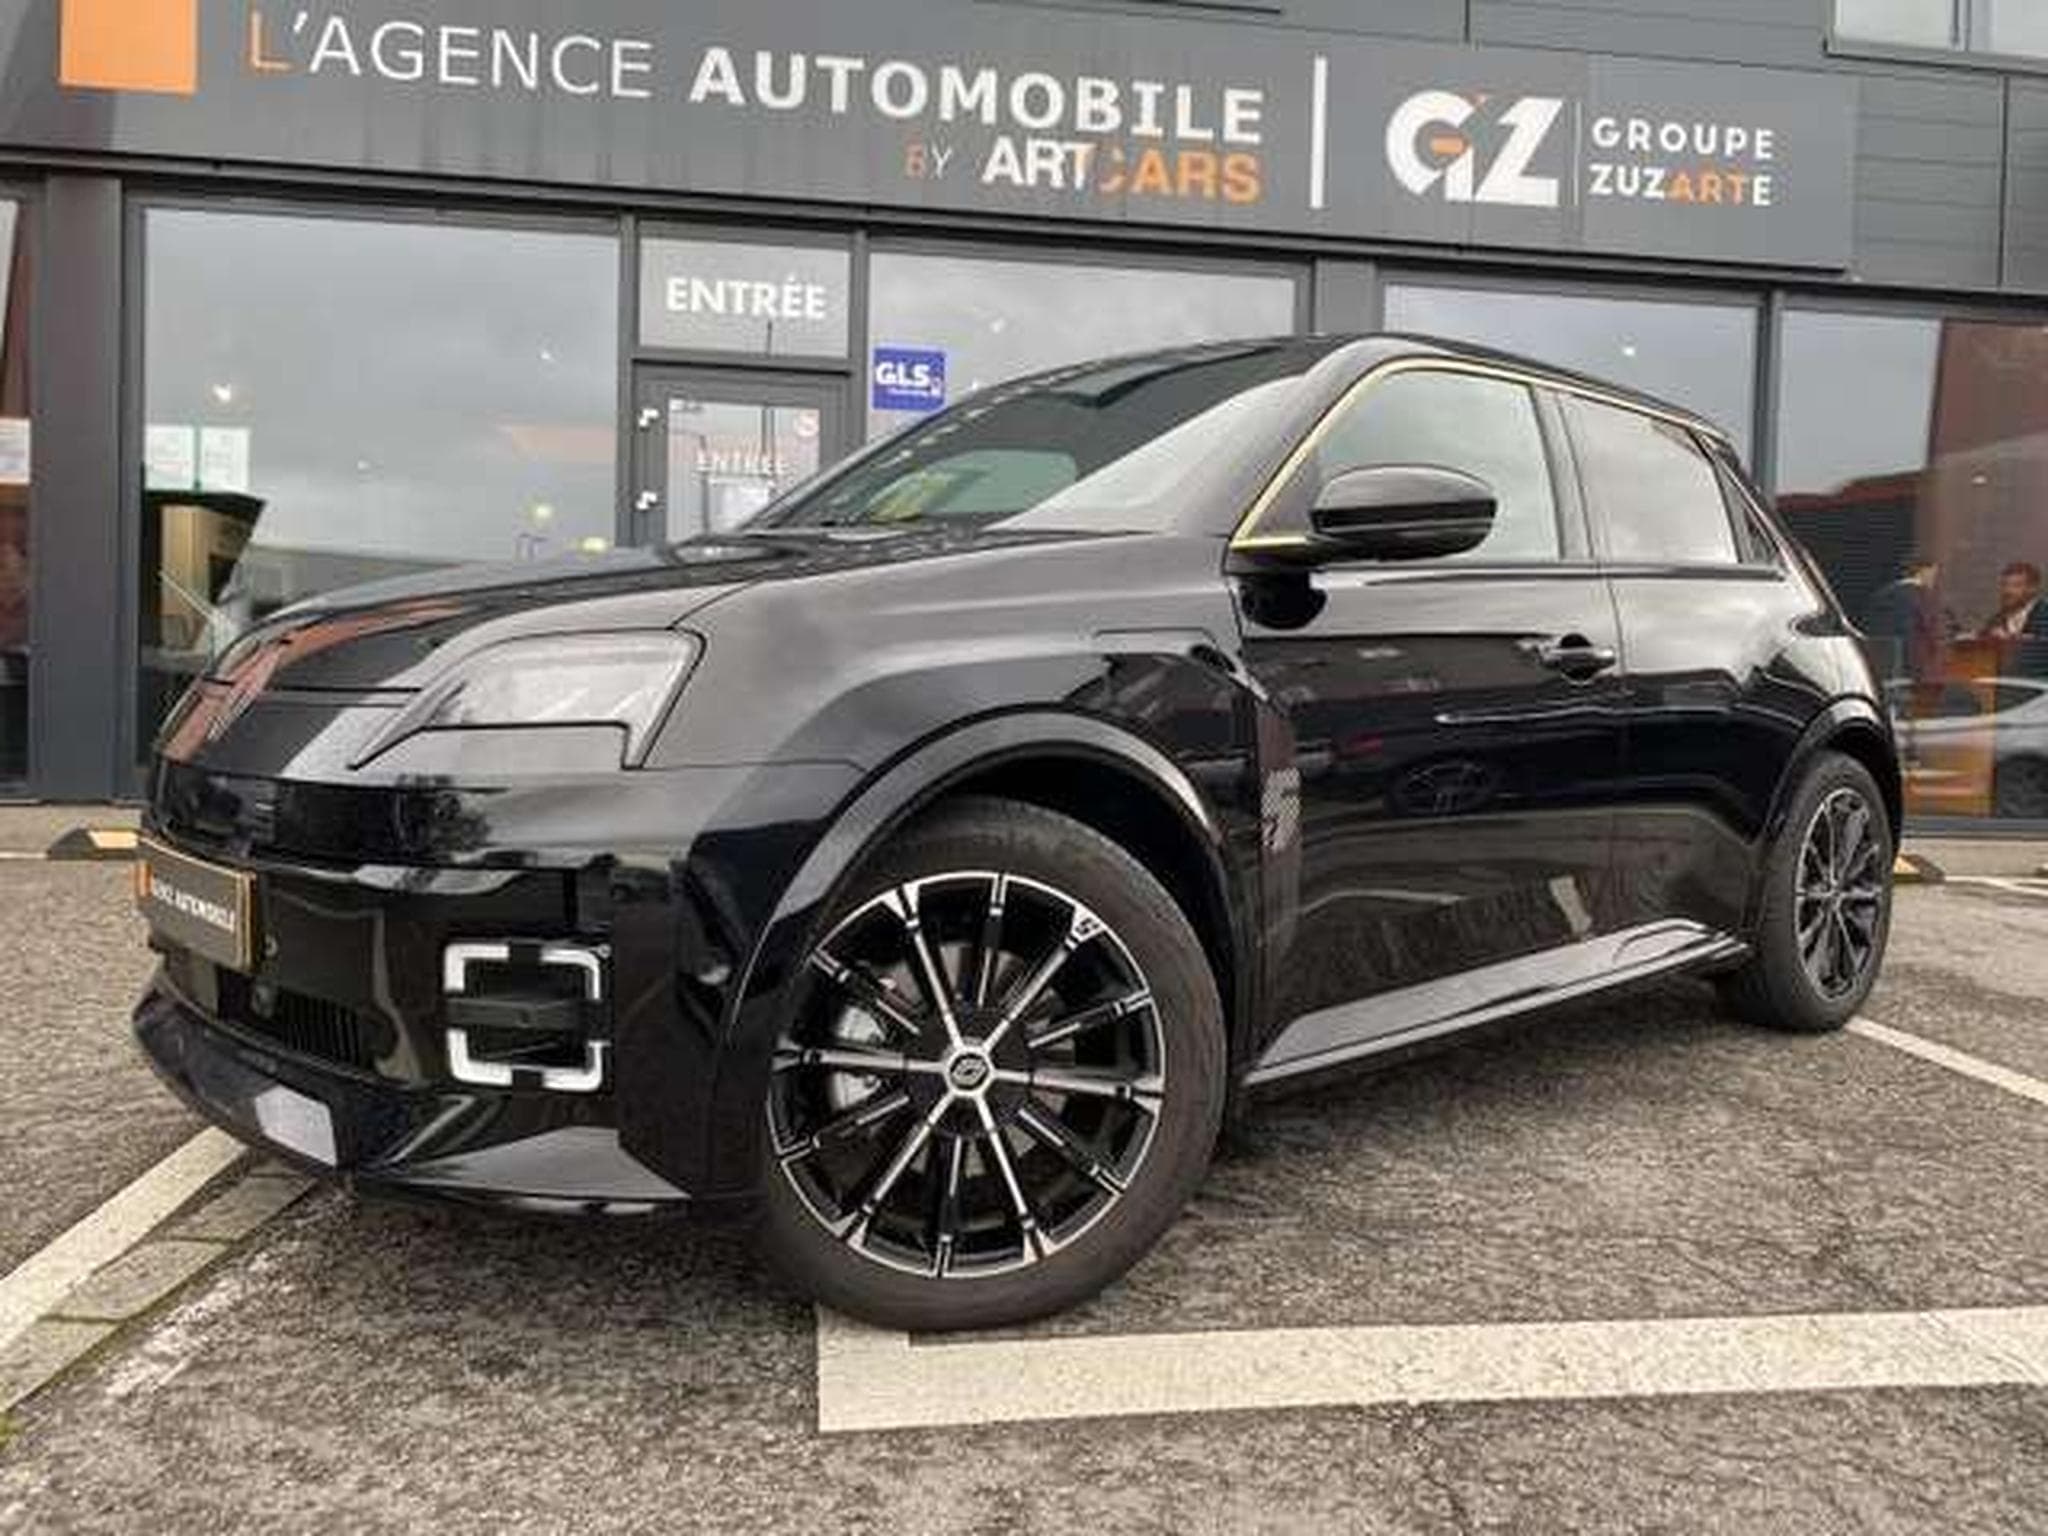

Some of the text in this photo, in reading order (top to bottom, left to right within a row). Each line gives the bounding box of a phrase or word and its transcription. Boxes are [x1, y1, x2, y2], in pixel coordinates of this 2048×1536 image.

[252, 11, 1264, 144] L'AGENCE AUTOMOBILE
[1591, 117, 1774, 159] GROUPE
[904, 142, 952, 180] BY
[1588, 164, 1773, 206] ZUZARTE
[666, 272, 828, 320] ENTRÉE
[876, 362, 930, 387] GLS
